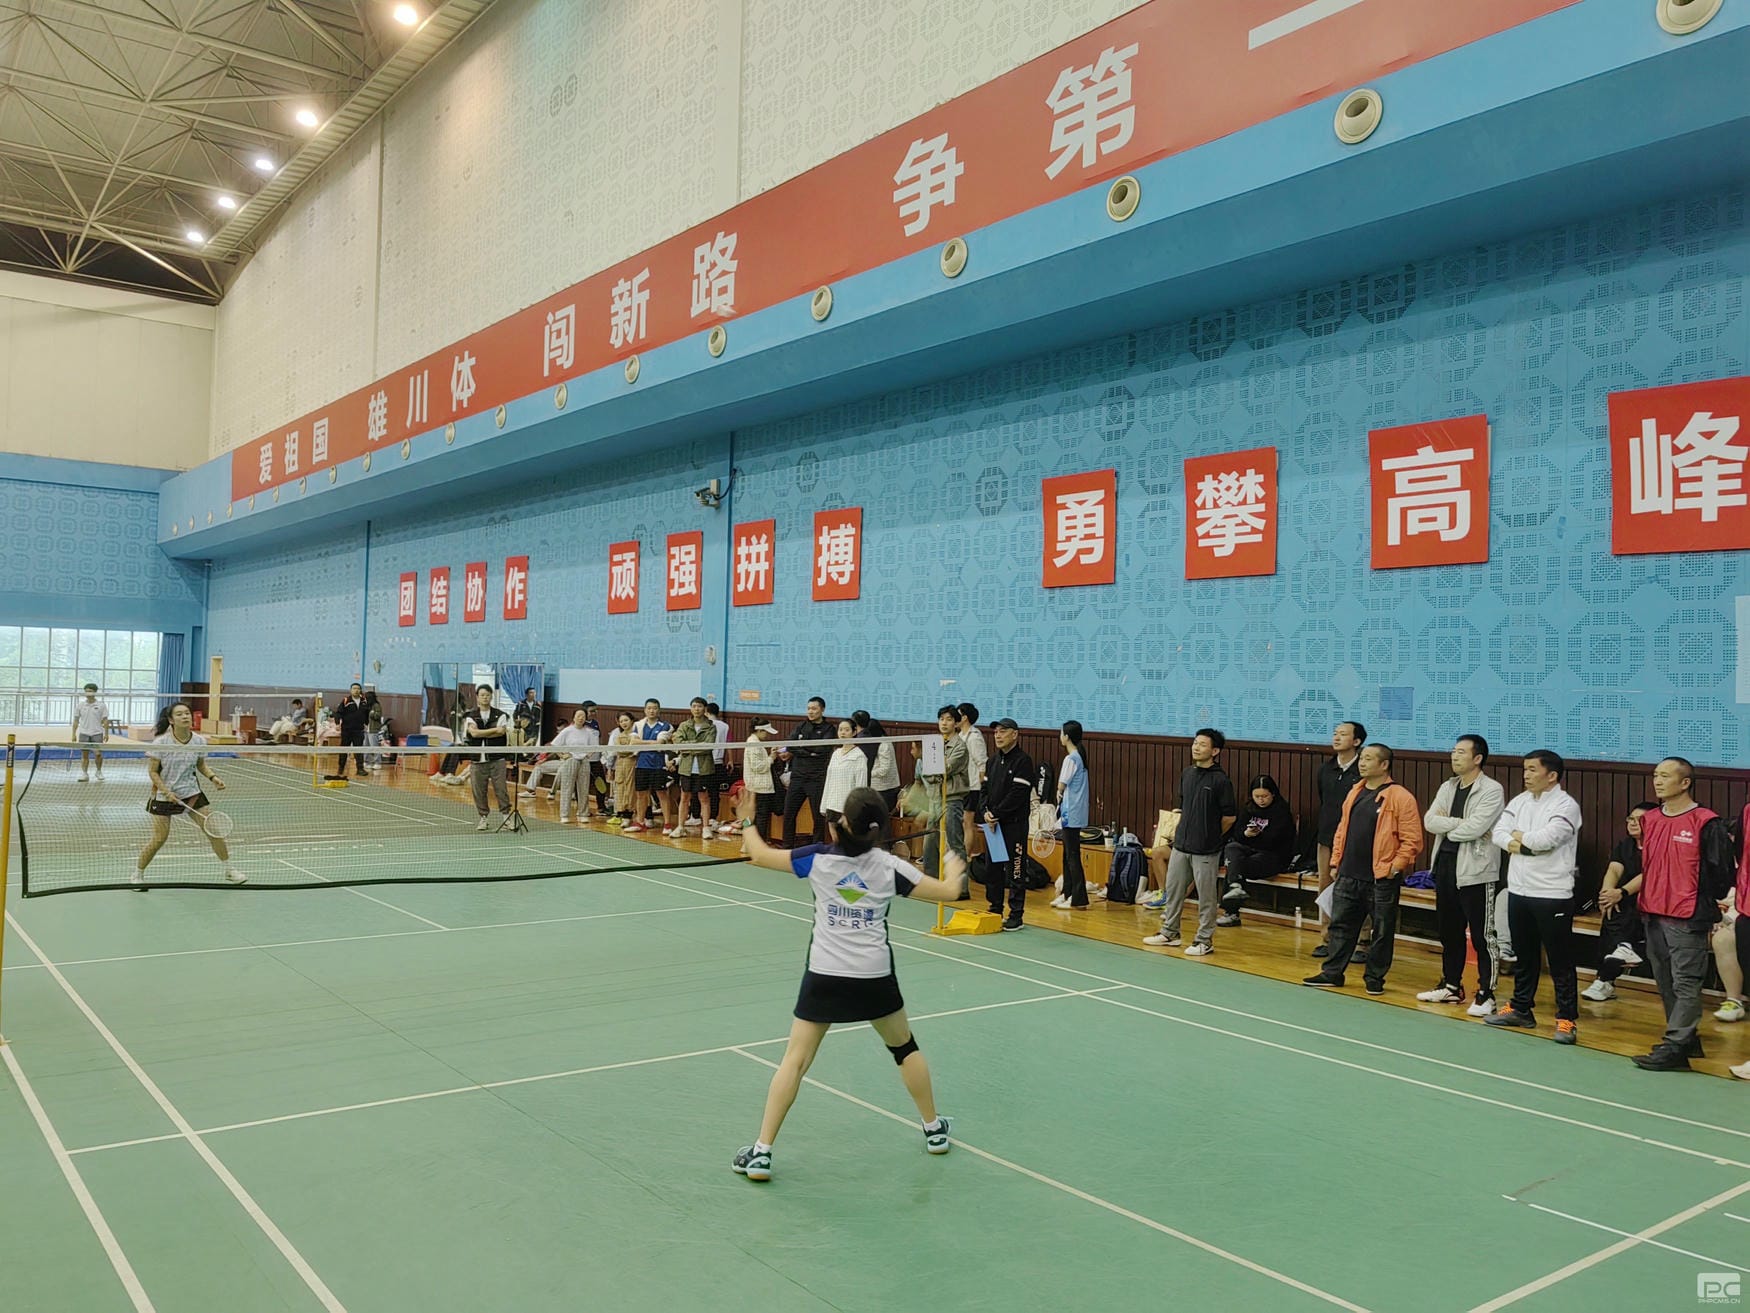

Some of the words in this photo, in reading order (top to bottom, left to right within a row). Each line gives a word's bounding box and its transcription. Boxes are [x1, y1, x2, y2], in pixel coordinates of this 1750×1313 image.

[259, 417, 329, 484] 爱祖国
[368, 350, 477, 442] 雄川体
[543, 231, 738, 376] 闯新路
[893, 0, 1363, 235] 争第一
[399, 566, 526, 618] 团结协作
[609, 524, 856, 601] 顽强拼搏
[1052, 411, 1750, 567] 勇攀高峰
